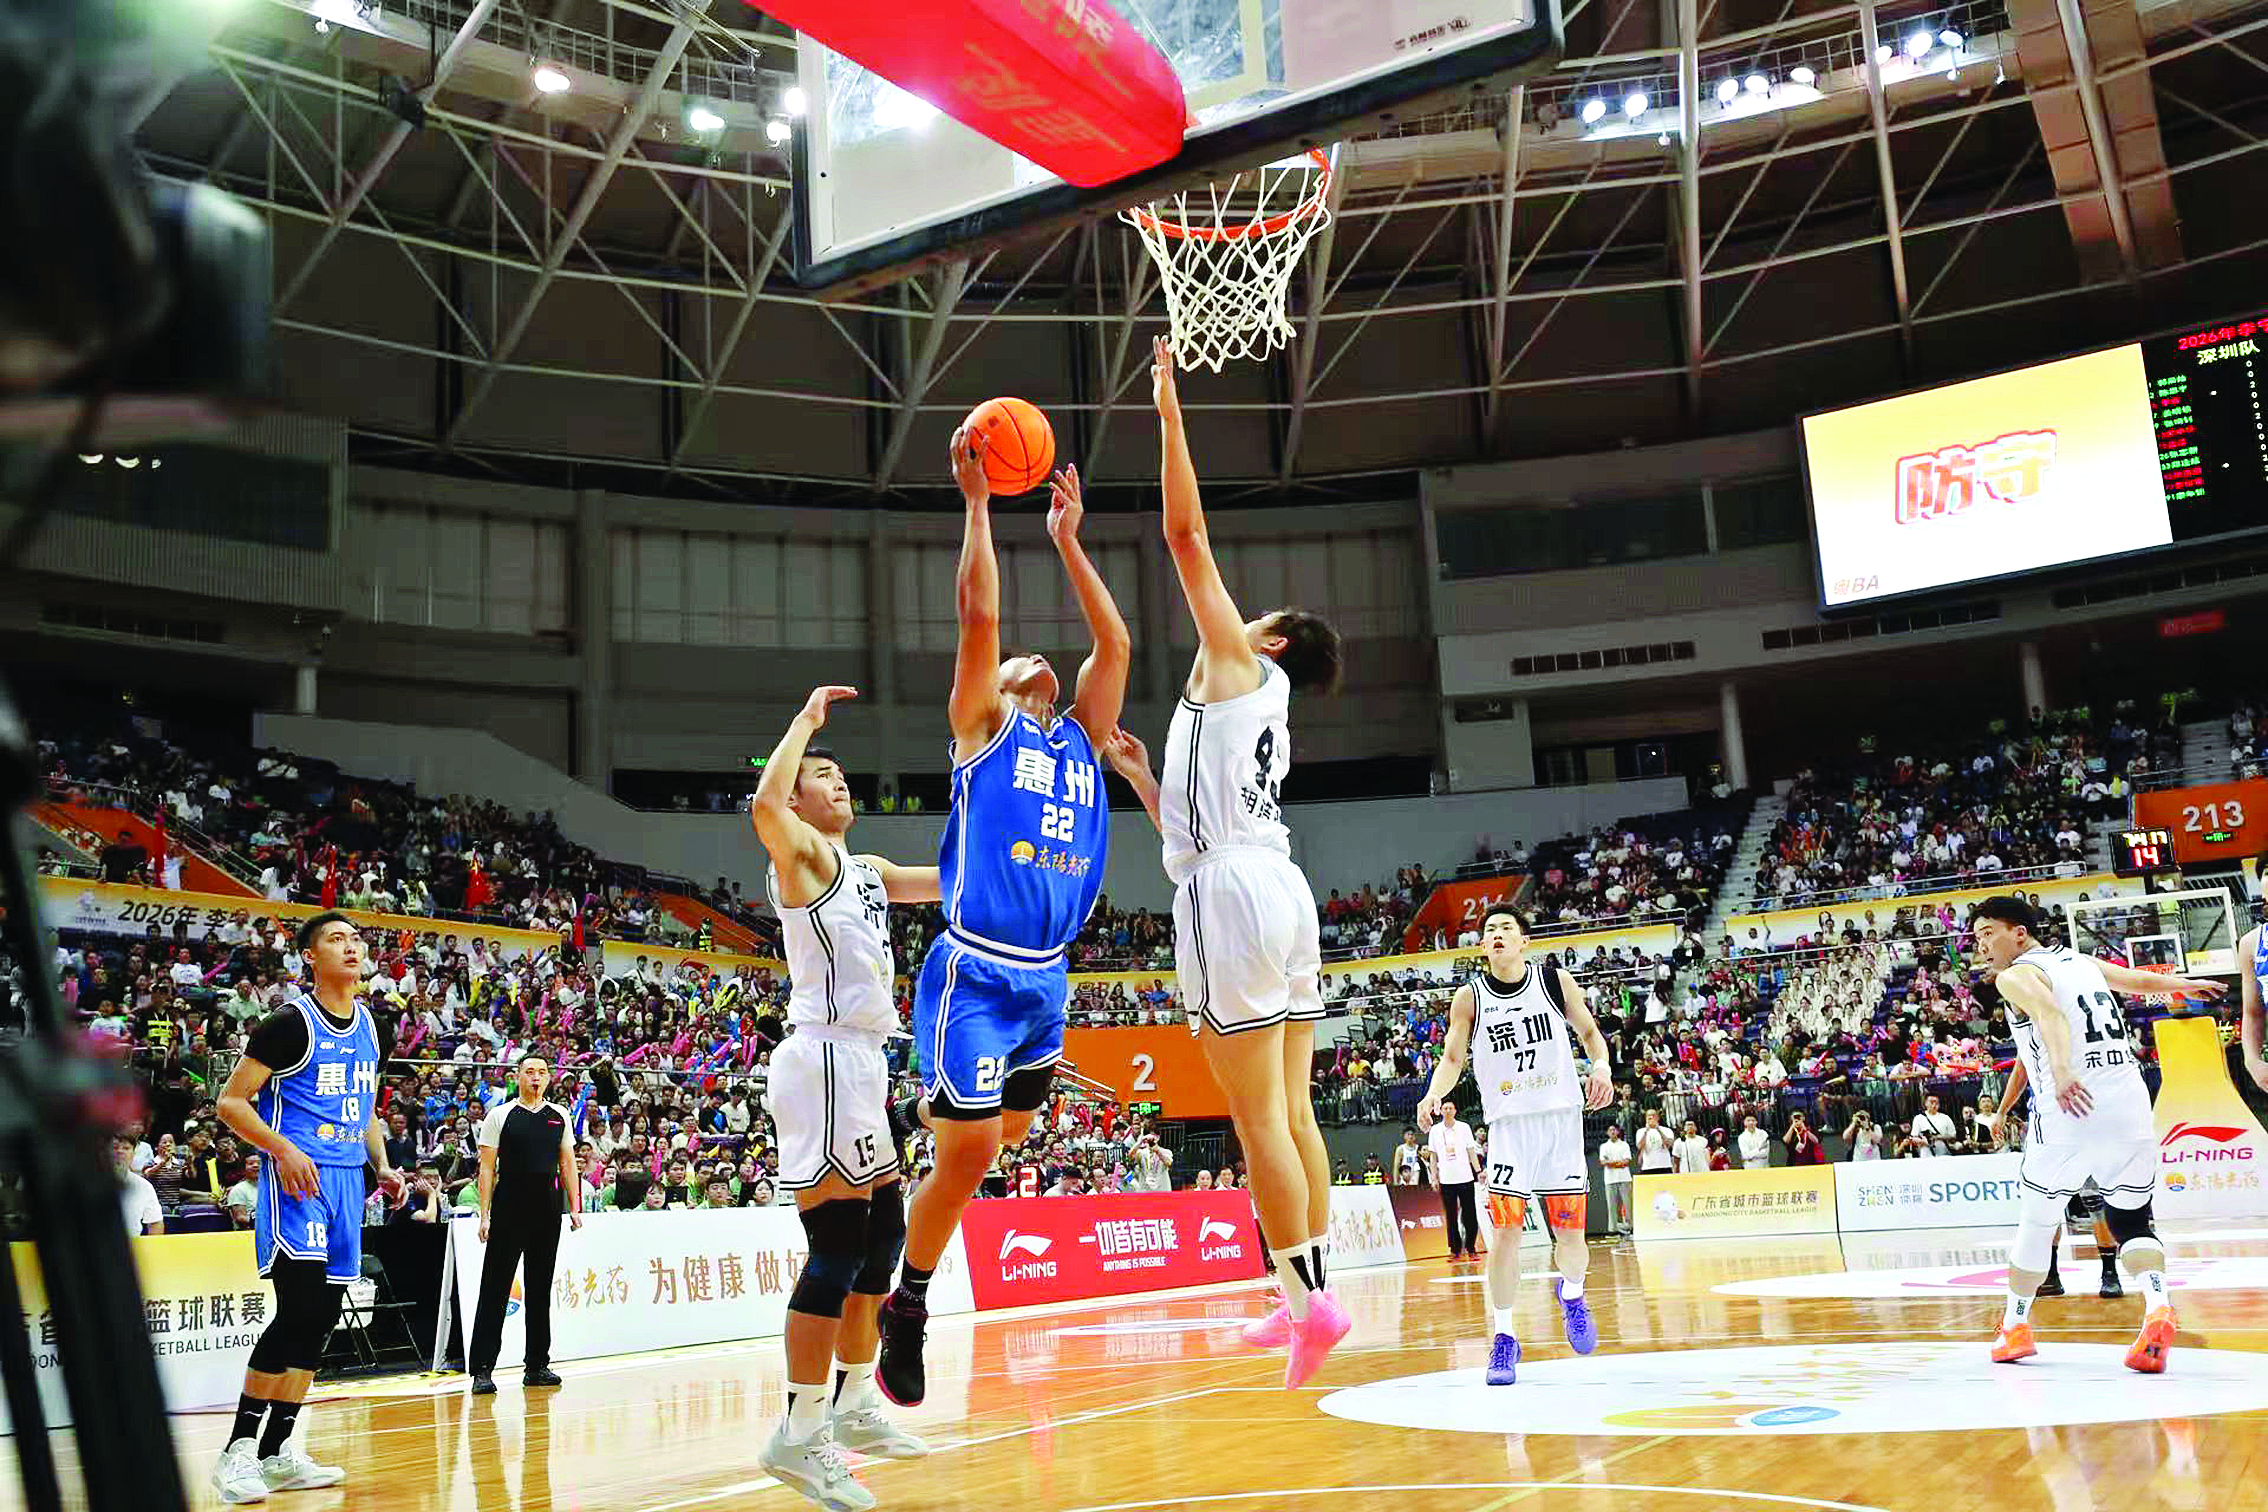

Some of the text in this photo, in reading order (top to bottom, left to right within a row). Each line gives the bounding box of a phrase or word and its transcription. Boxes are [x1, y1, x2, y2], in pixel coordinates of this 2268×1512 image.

[2197, 339, 2260, 365] 深圳队
[1895, 428, 2057, 524] 防守
[1013, 746, 1094, 808] 惠州
[1041, 803, 1075, 843] 22
[2182, 801, 2244, 832] 213
[118, 900, 198, 927] 2026年
[2077, 991, 2125, 1043] 13
[1486, 1013, 1553, 1053] 深圳
[1132, 1054, 1156, 1091] 2
[1514, 1049, 1536, 1073] 77
[2085, 1050, 2134, 1069] 宋中
[315, 1061, 376, 1096] 惠州
[341, 1097, 360, 1122] 18
[854, 1134, 876, 1168] 15
[2162, 1147, 2253, 1163] LI-NING
[1020, 1167, 1037, 1198] 2
[1493, 1164, 1514, 1186] 77
[1691, 1190, 1818, 1211] 广东省城市篮球联赛
[306, 1221, 326, 1248] 18
[1078, 1218, 1179, 1256] 一切皆有可能
[1103, 1260, 1132, 1272] ANYTHING
[1139, 1257, 1166, 1269] POSSIBLE
[1201, 1245, 1241, 1261] LI-NING
[650, 1252, 746, 1305] 为健康
[1001, 1261, 1057, 1281] LI-NING
[146, 1291, 266, 1334] 篮球联赛
[152, 1333, 263, 1356] KETBALL LEAGU
